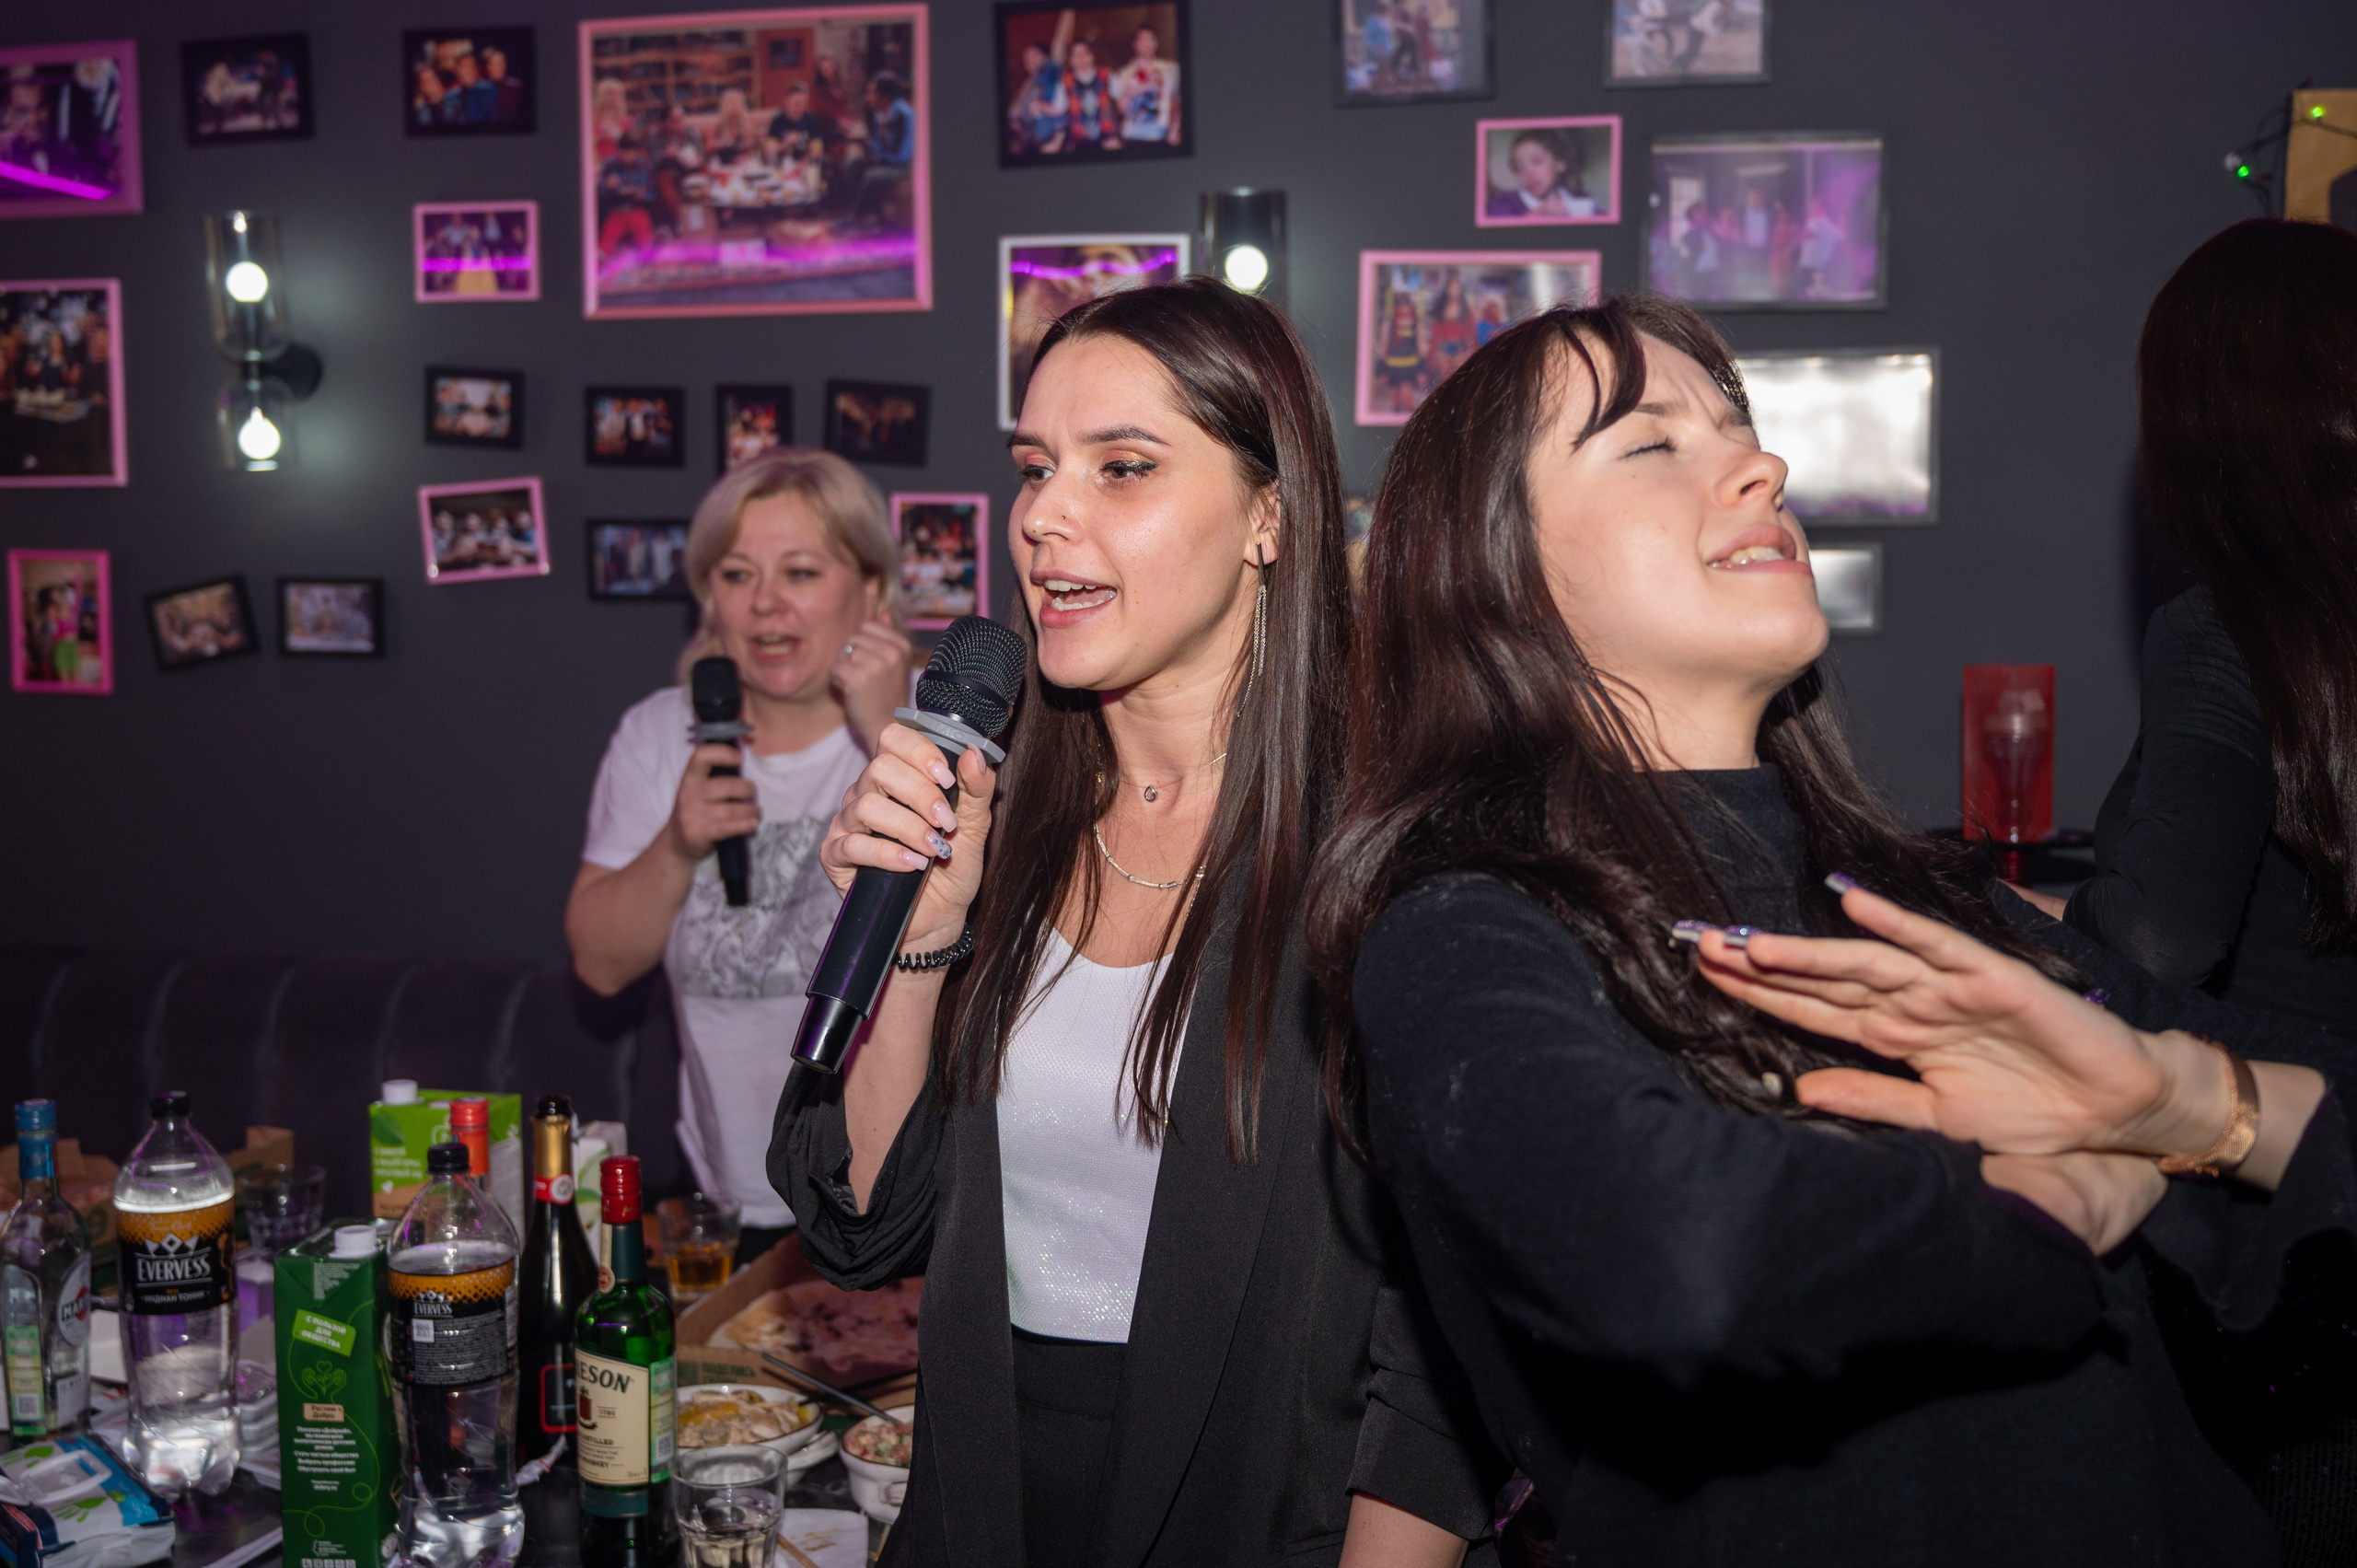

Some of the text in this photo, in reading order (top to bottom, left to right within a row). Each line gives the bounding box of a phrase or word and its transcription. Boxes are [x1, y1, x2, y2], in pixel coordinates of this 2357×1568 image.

[935, 723, 965, 740] MIC
[137, 1253, 211, 1282] EVERVESS
[413, 1302, 453, 1316] EVERVESS
